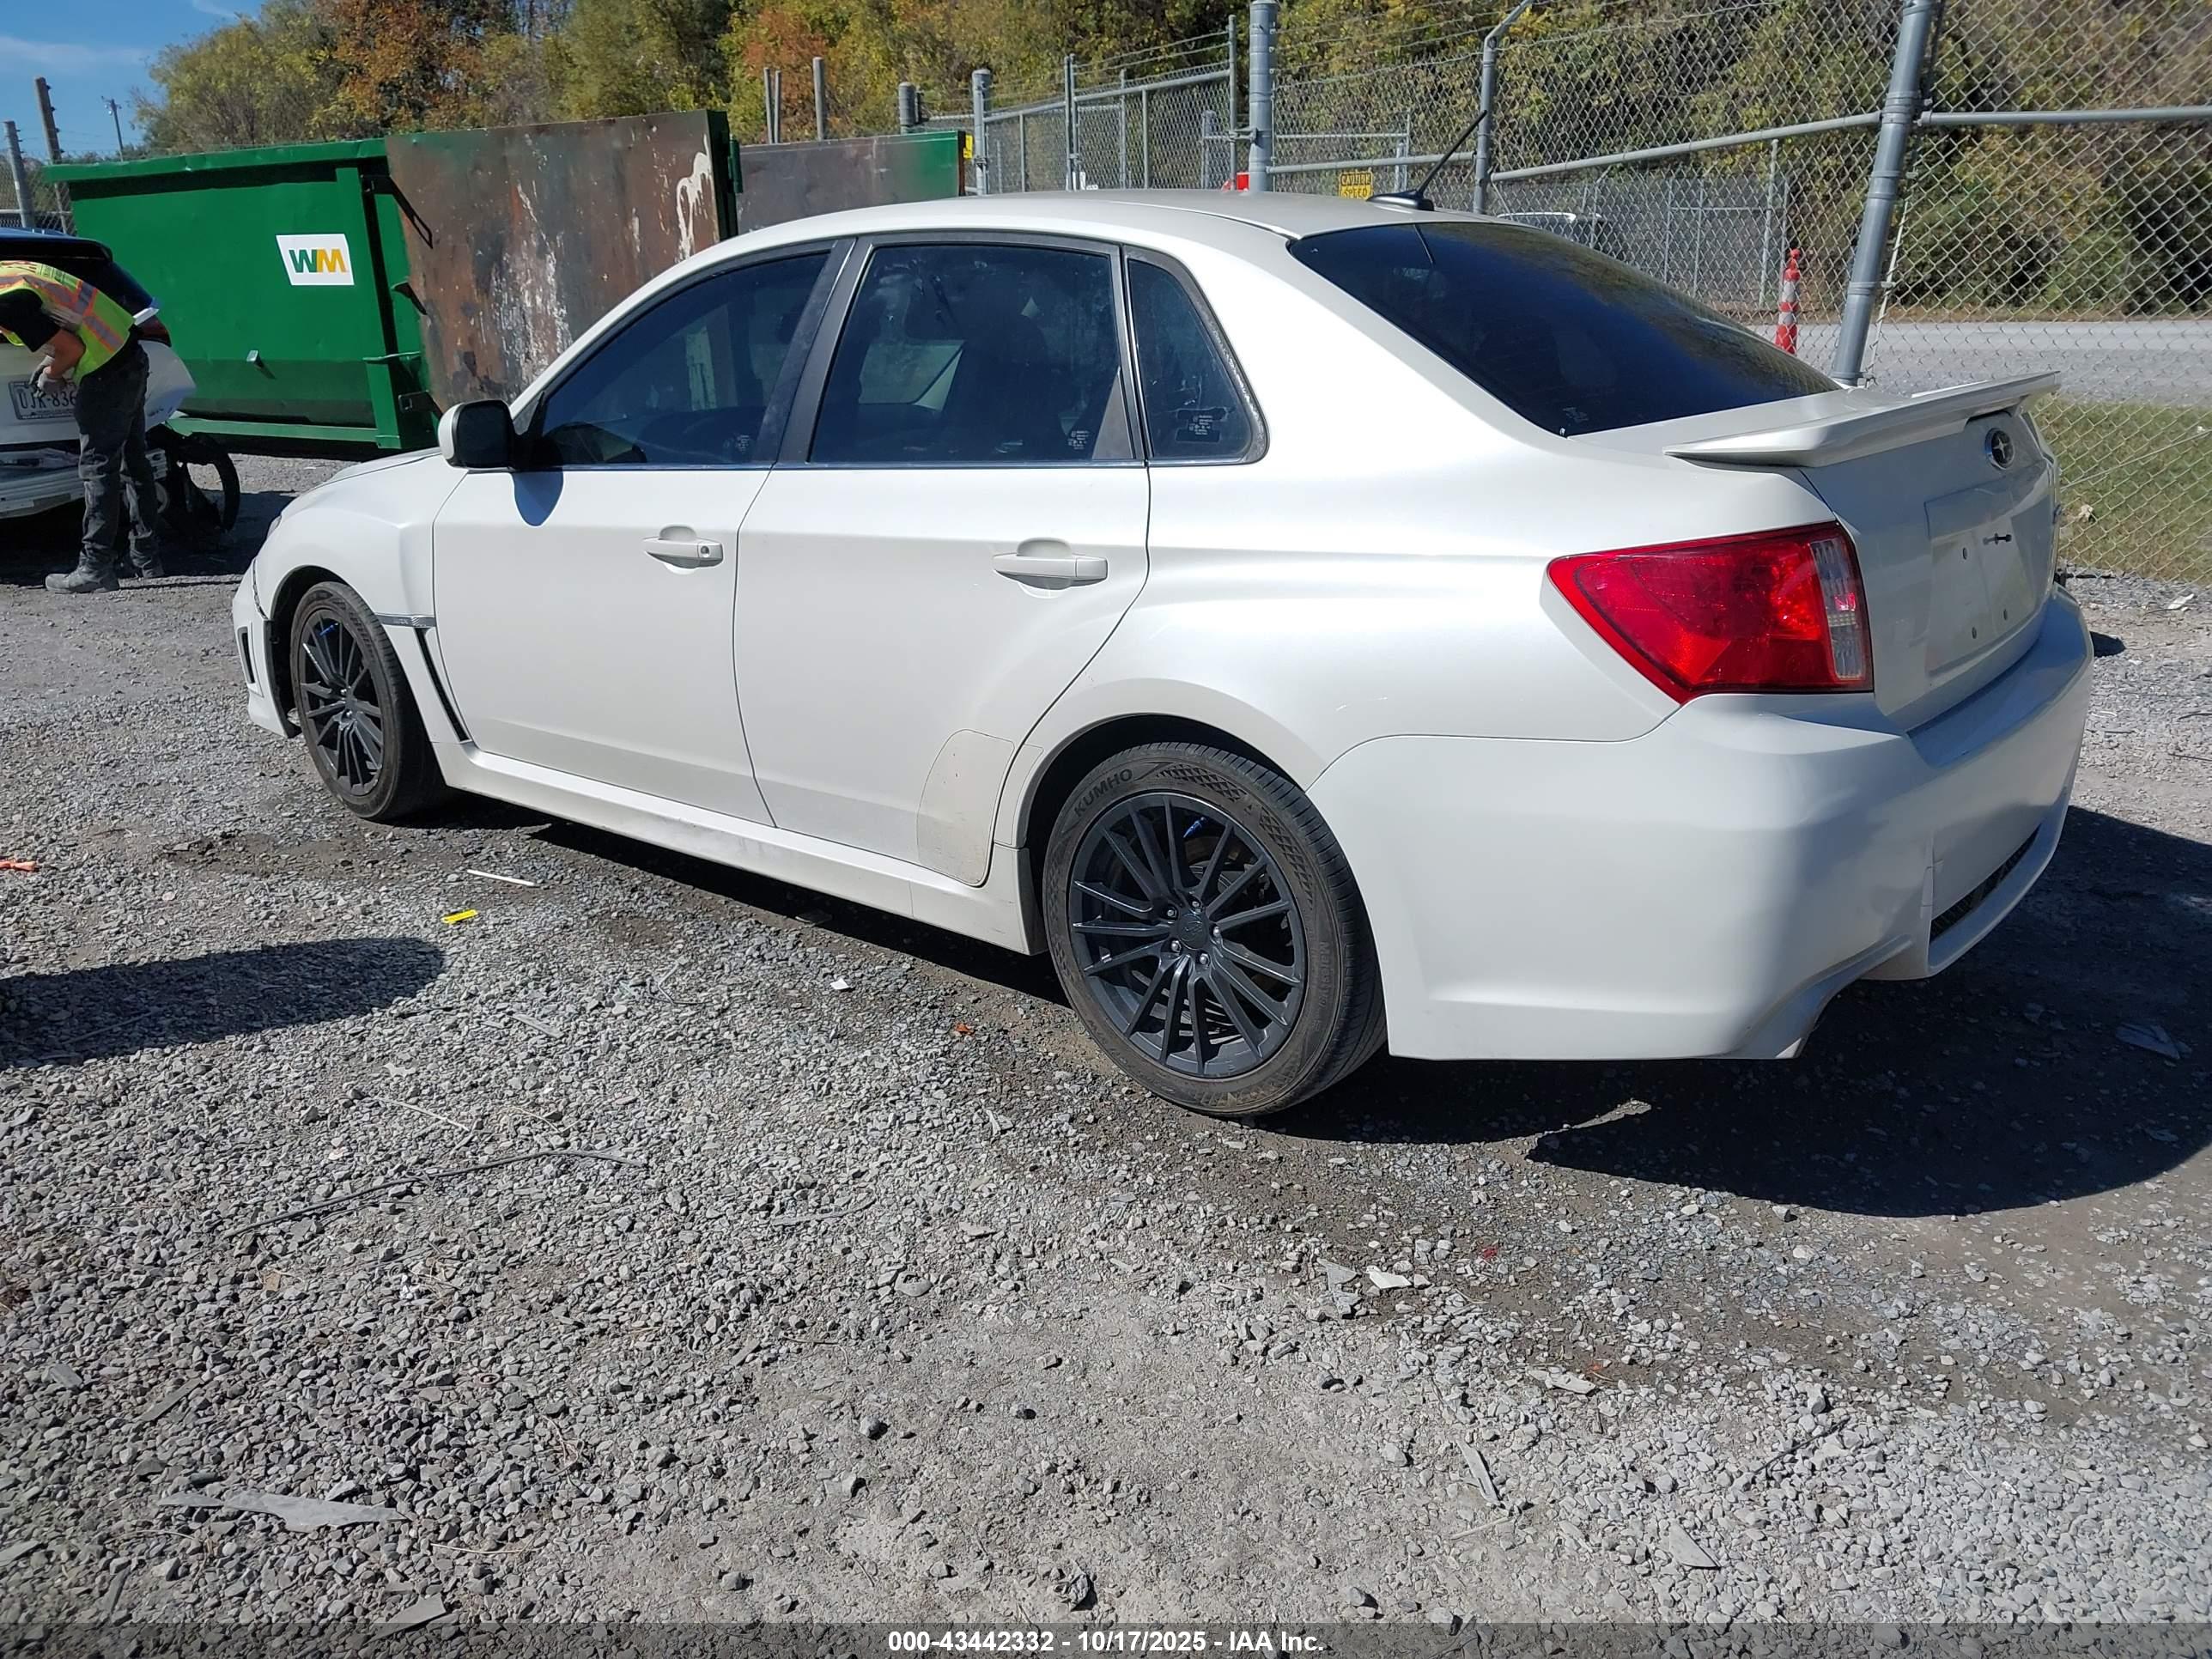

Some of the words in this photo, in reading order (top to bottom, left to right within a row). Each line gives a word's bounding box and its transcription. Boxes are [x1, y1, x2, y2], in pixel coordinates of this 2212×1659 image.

[1340, 173, 1371, 185] CAUTION
[1344, 187, 1368, 198] SPEED
[289, 249, 348, 273] WM
[1074, 769, 1133, 817] KUMHO
